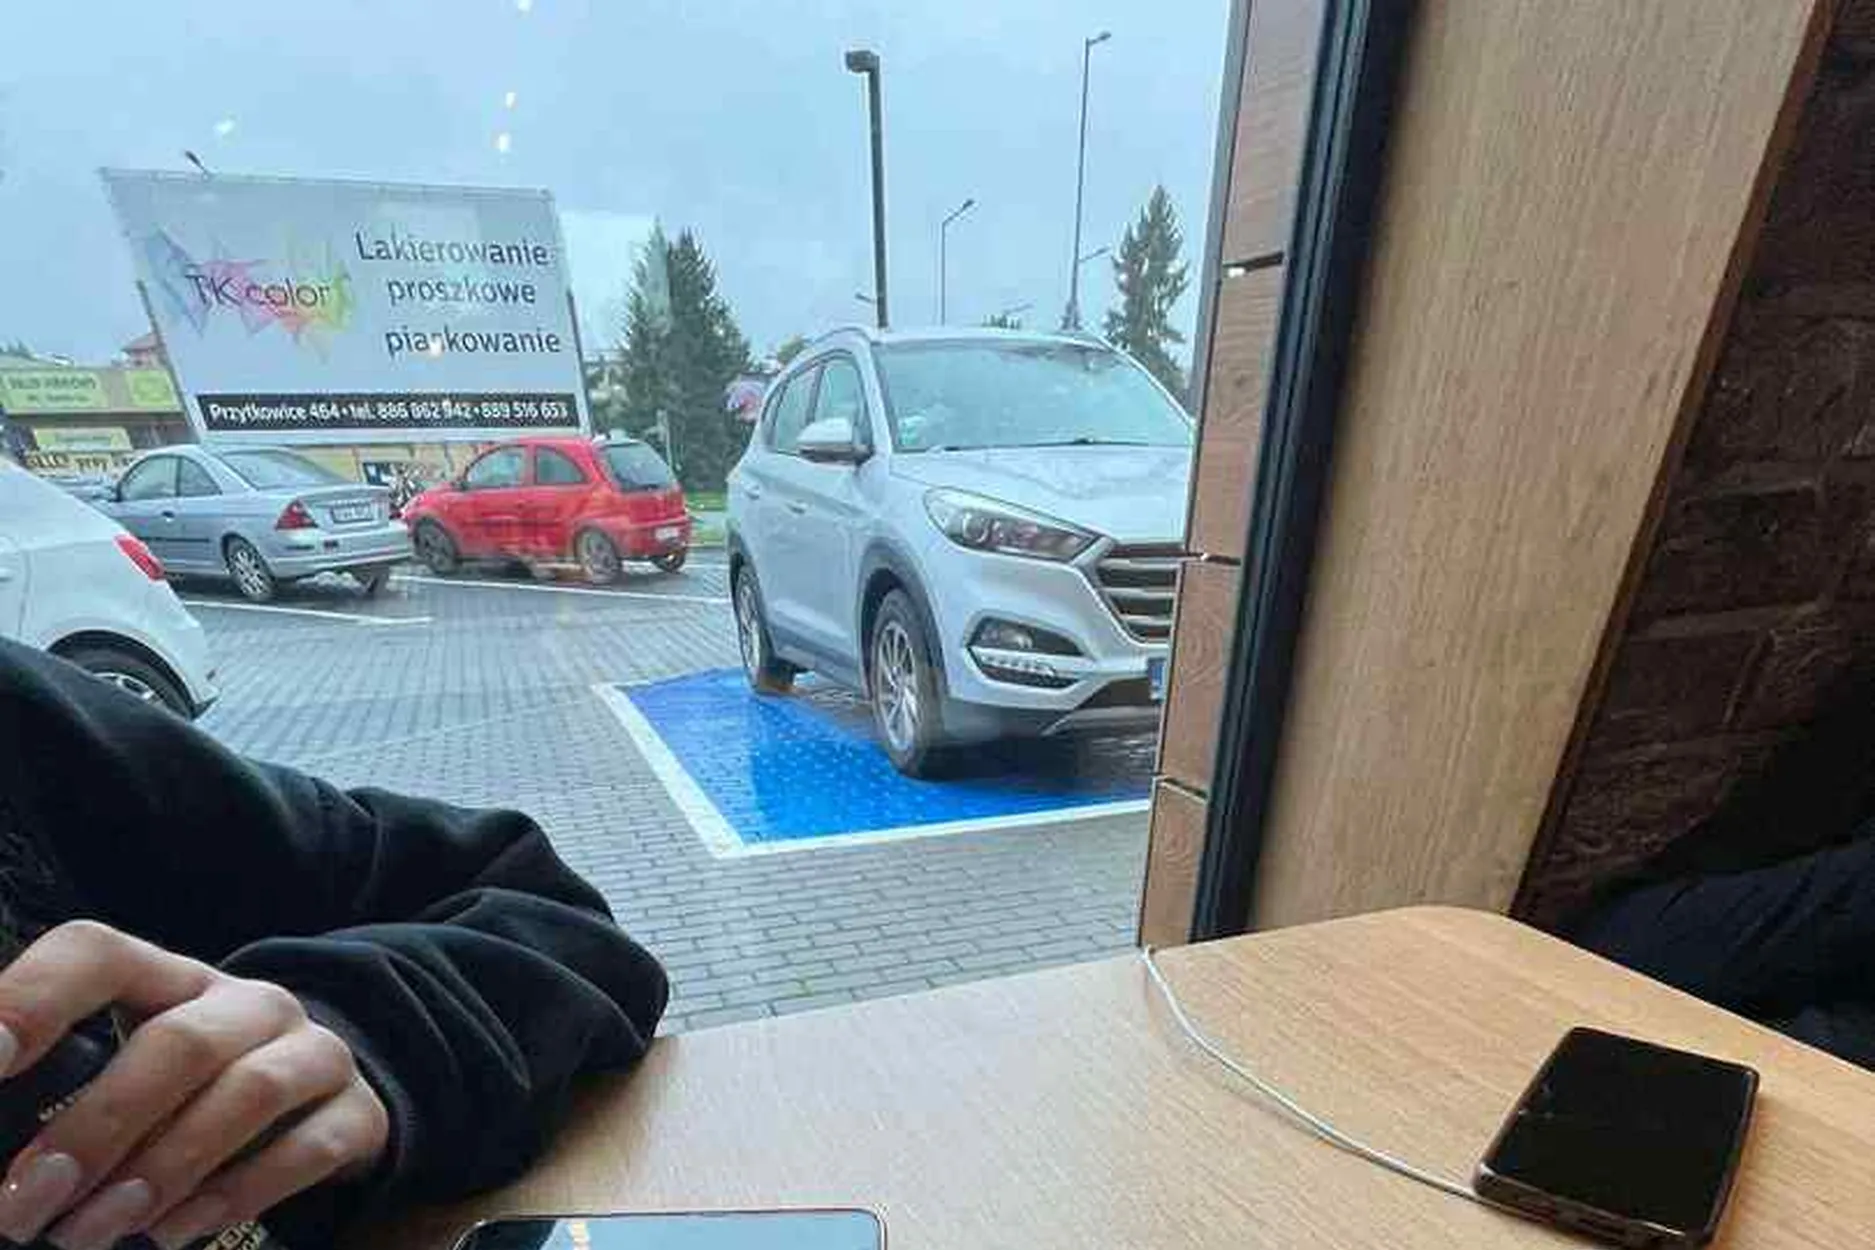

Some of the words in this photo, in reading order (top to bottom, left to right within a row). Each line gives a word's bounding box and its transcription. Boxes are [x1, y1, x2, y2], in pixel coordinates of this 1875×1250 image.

[356, 227, 548, 266] Lakierowanie
[185, 273, 232, 305] TK
[245, 275, 332, 307] color
[388, 276, 537, 308] proszkowe
[208, 402, 307, 423] Przytkowice
